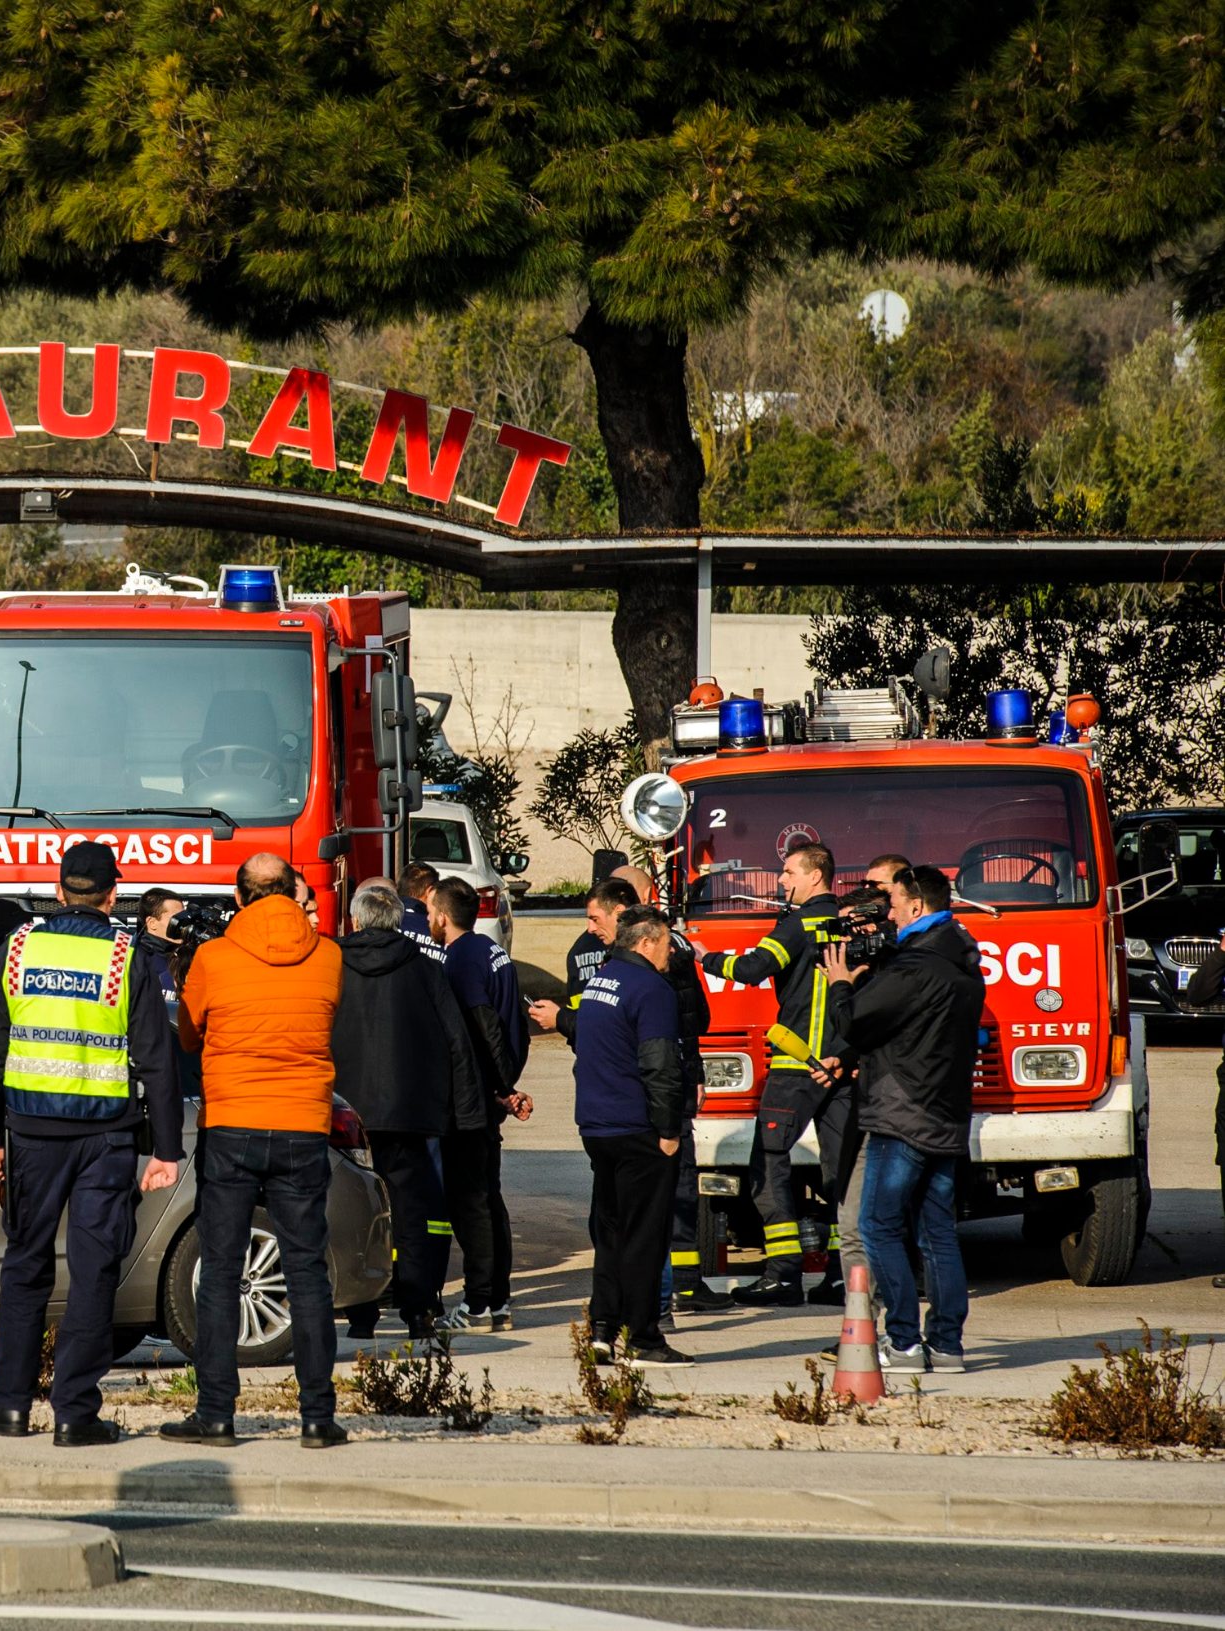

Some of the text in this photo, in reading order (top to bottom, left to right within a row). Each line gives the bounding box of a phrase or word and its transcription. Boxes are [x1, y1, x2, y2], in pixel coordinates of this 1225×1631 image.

[709, 808, 727, 828] 2
[574, 950, 606, 968] VATRO
[25, 974, 97, 995] POLICIJA
[33, 1028, 83, 1043] POLICIJA
[1011, 1022, 1091, 1037] STEYR
